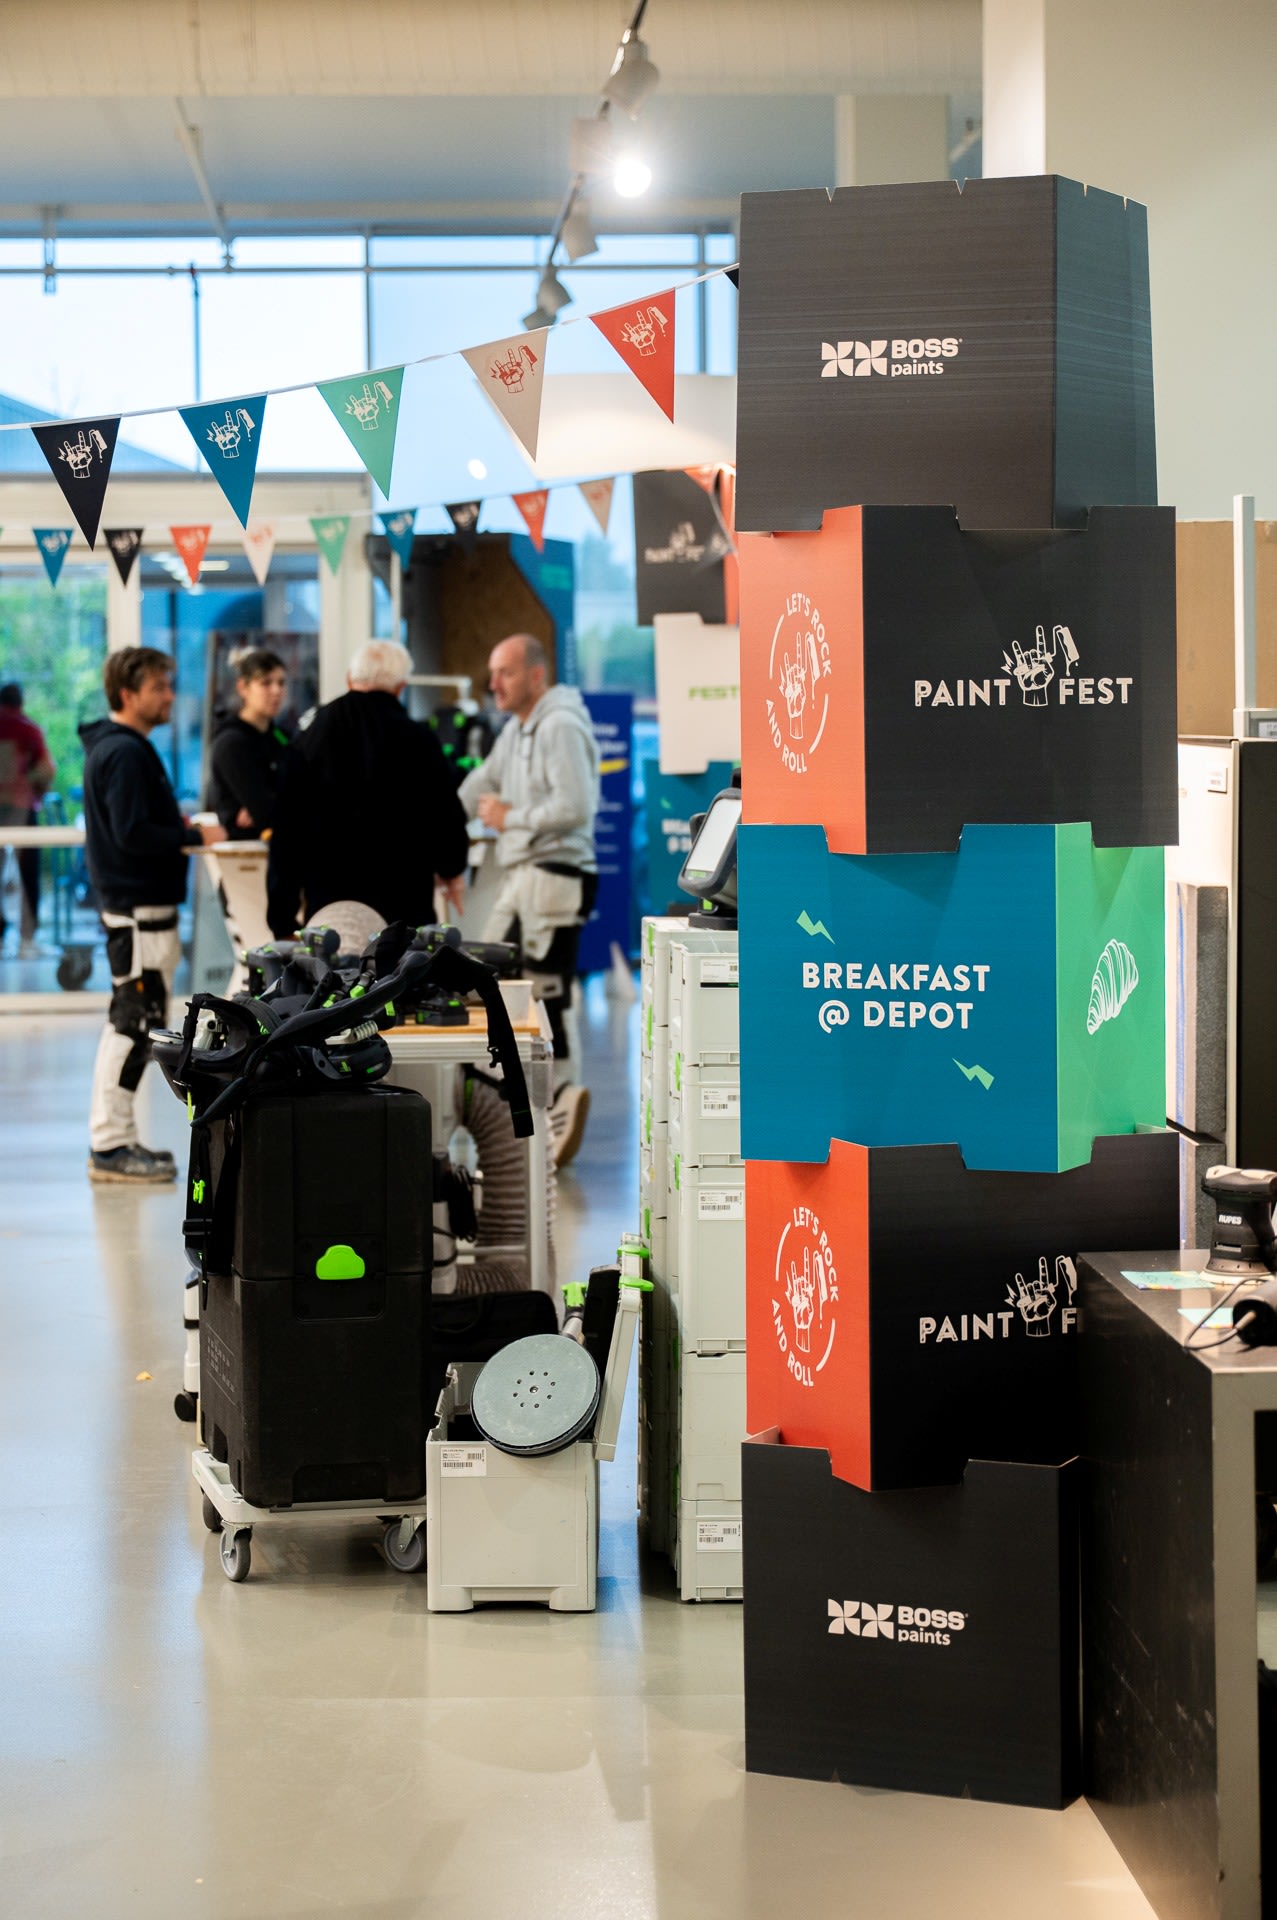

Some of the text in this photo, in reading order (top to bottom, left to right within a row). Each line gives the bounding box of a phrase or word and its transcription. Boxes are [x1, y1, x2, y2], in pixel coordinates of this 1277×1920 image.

[891, 337, 959, 359] BOSS
[891, 359, 944, 377] paints
[786, 592, 832, 678] LET'S ROCK
[914, 677, 1134, 707] PAINT FEST
[765, 698, 808, 774] AND ROLL
[802, 961, 991, 992] BREAKFAST
[818, 999, 974, 1034] @ DEPOT
[793, 1206, 839, 1303] LET'S ROCK
[771, 1298, 815, 1387] AND ROLL
[919, 1311, 1015, 1345] PAINT
[897, 1605, 966, 1631] BOSS
[898, 1627, 951, 1646] paints
